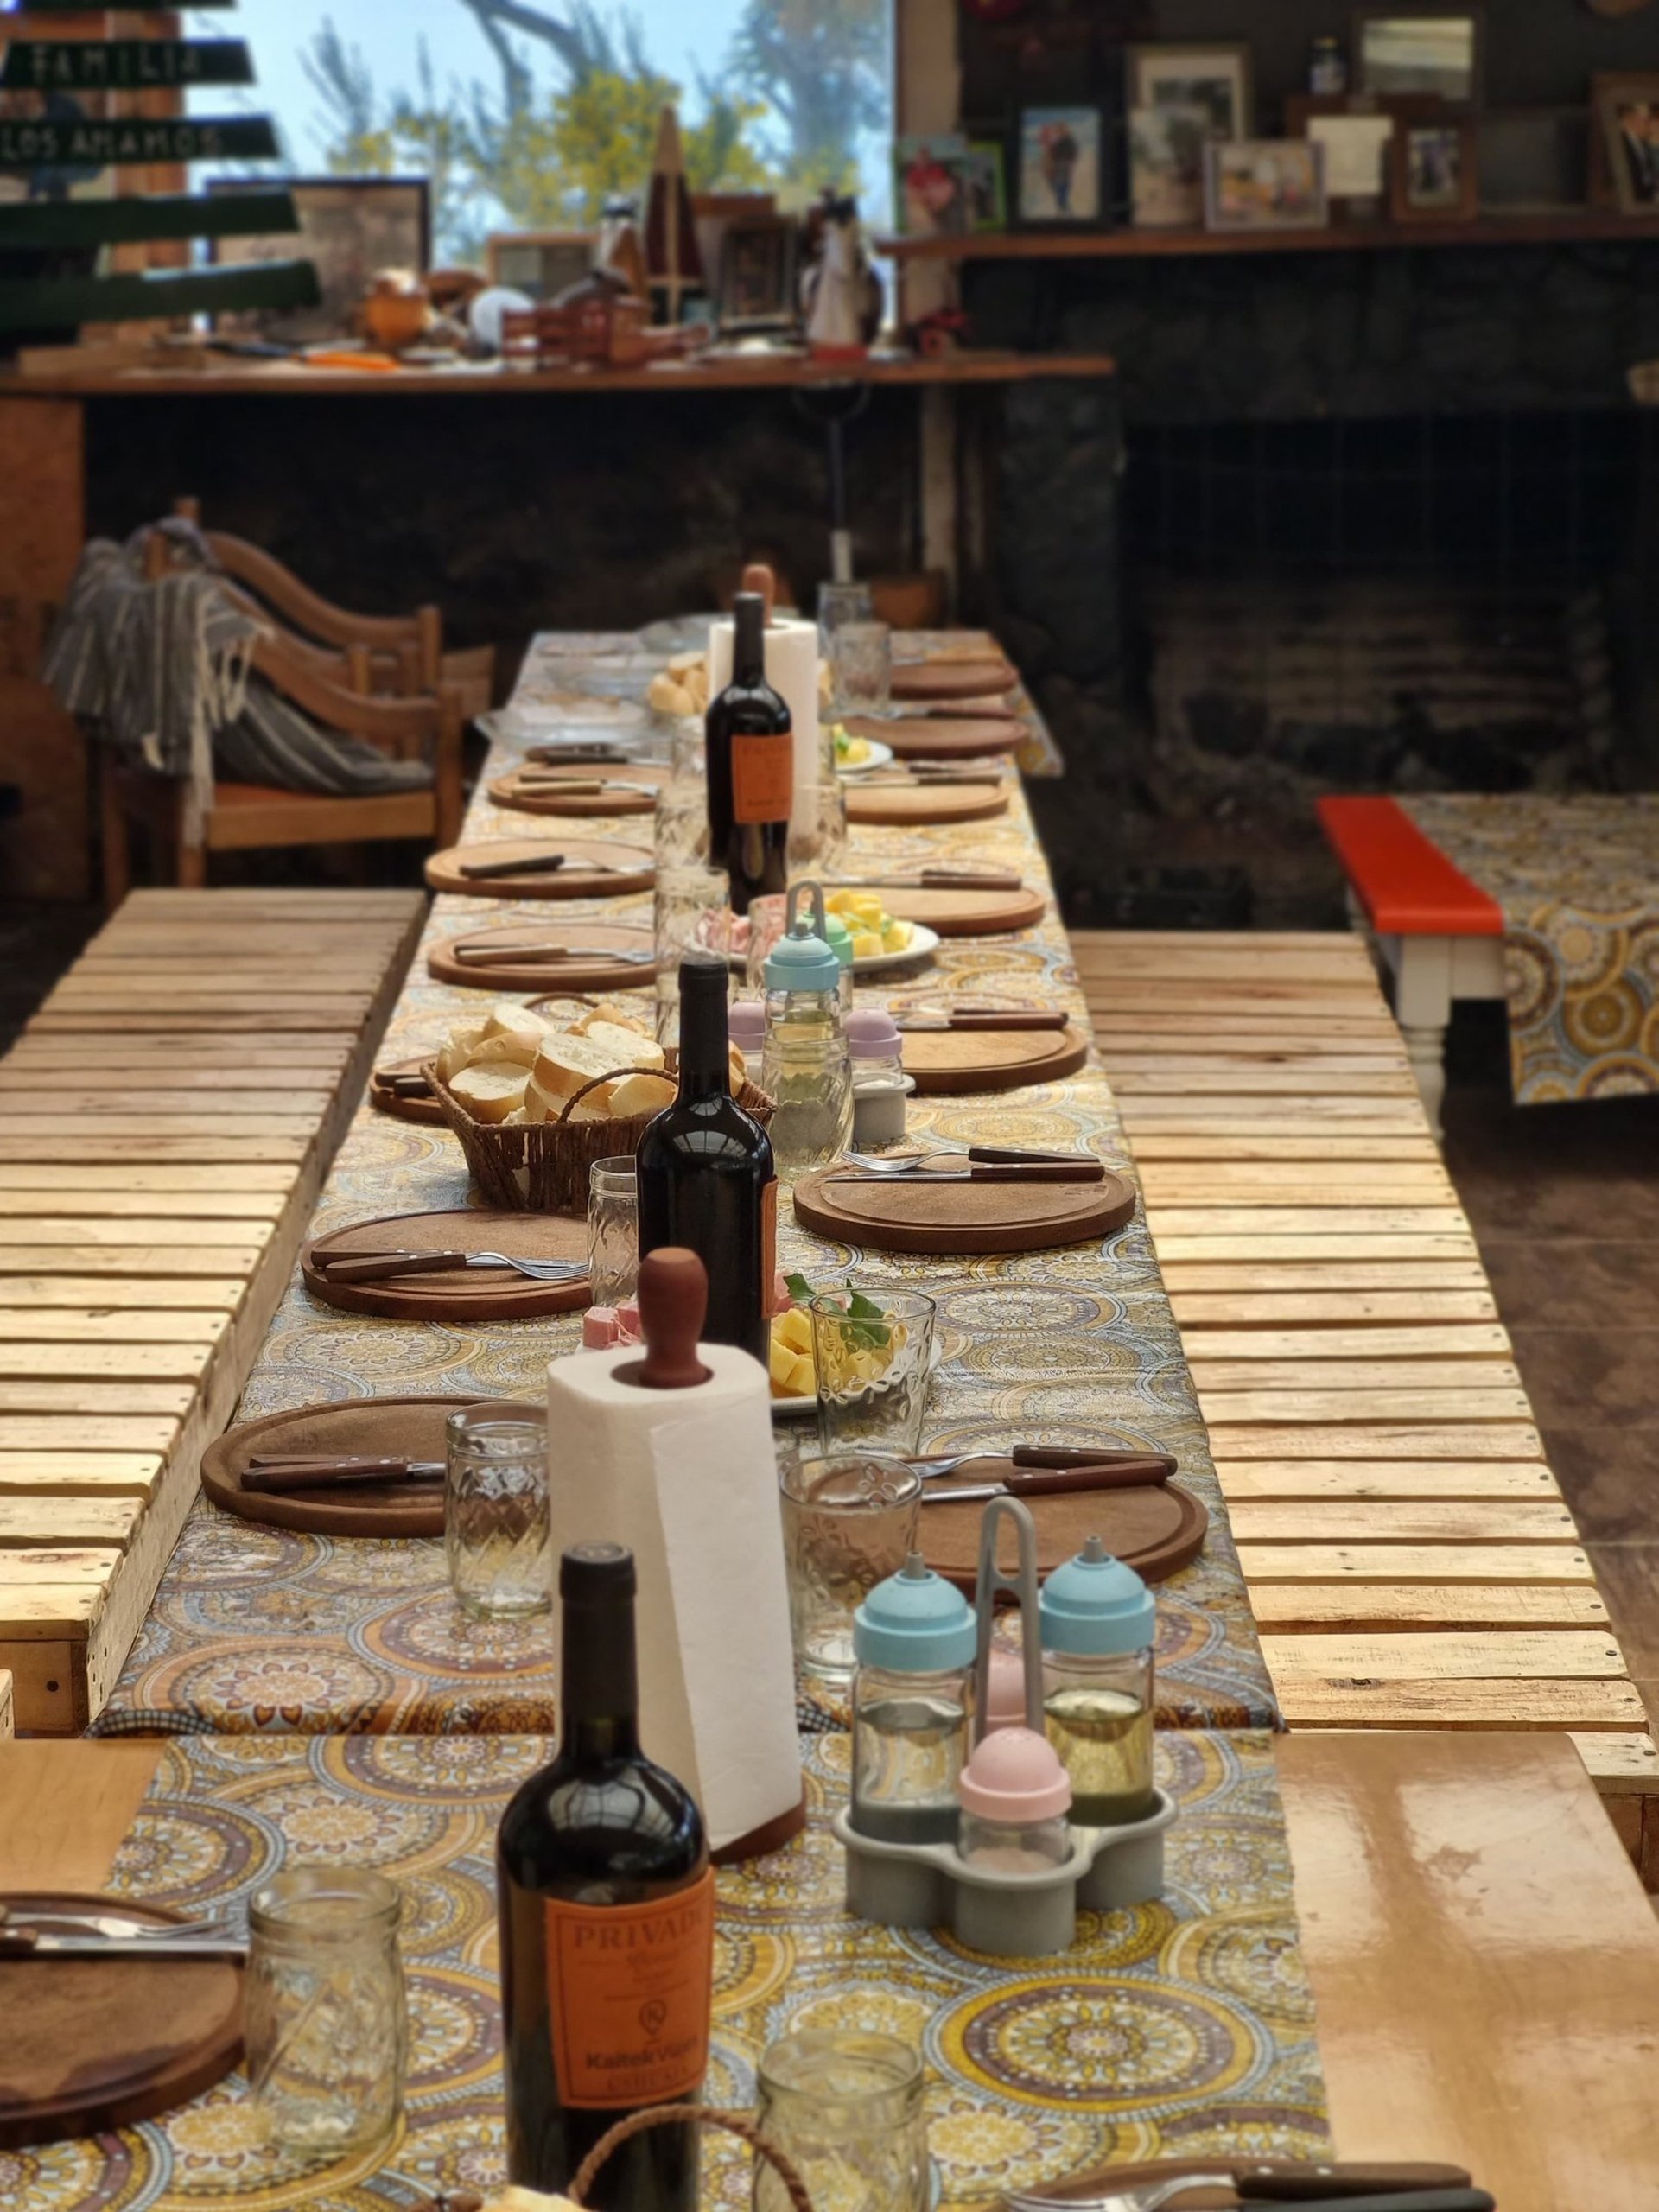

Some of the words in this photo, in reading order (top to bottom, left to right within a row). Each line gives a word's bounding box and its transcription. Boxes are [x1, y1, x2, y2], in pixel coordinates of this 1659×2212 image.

[33, 44, 200, 80] FAMILIA
[1, 126, 58, 161] LOS
[72, 125, 225, 157] AMAMOS
